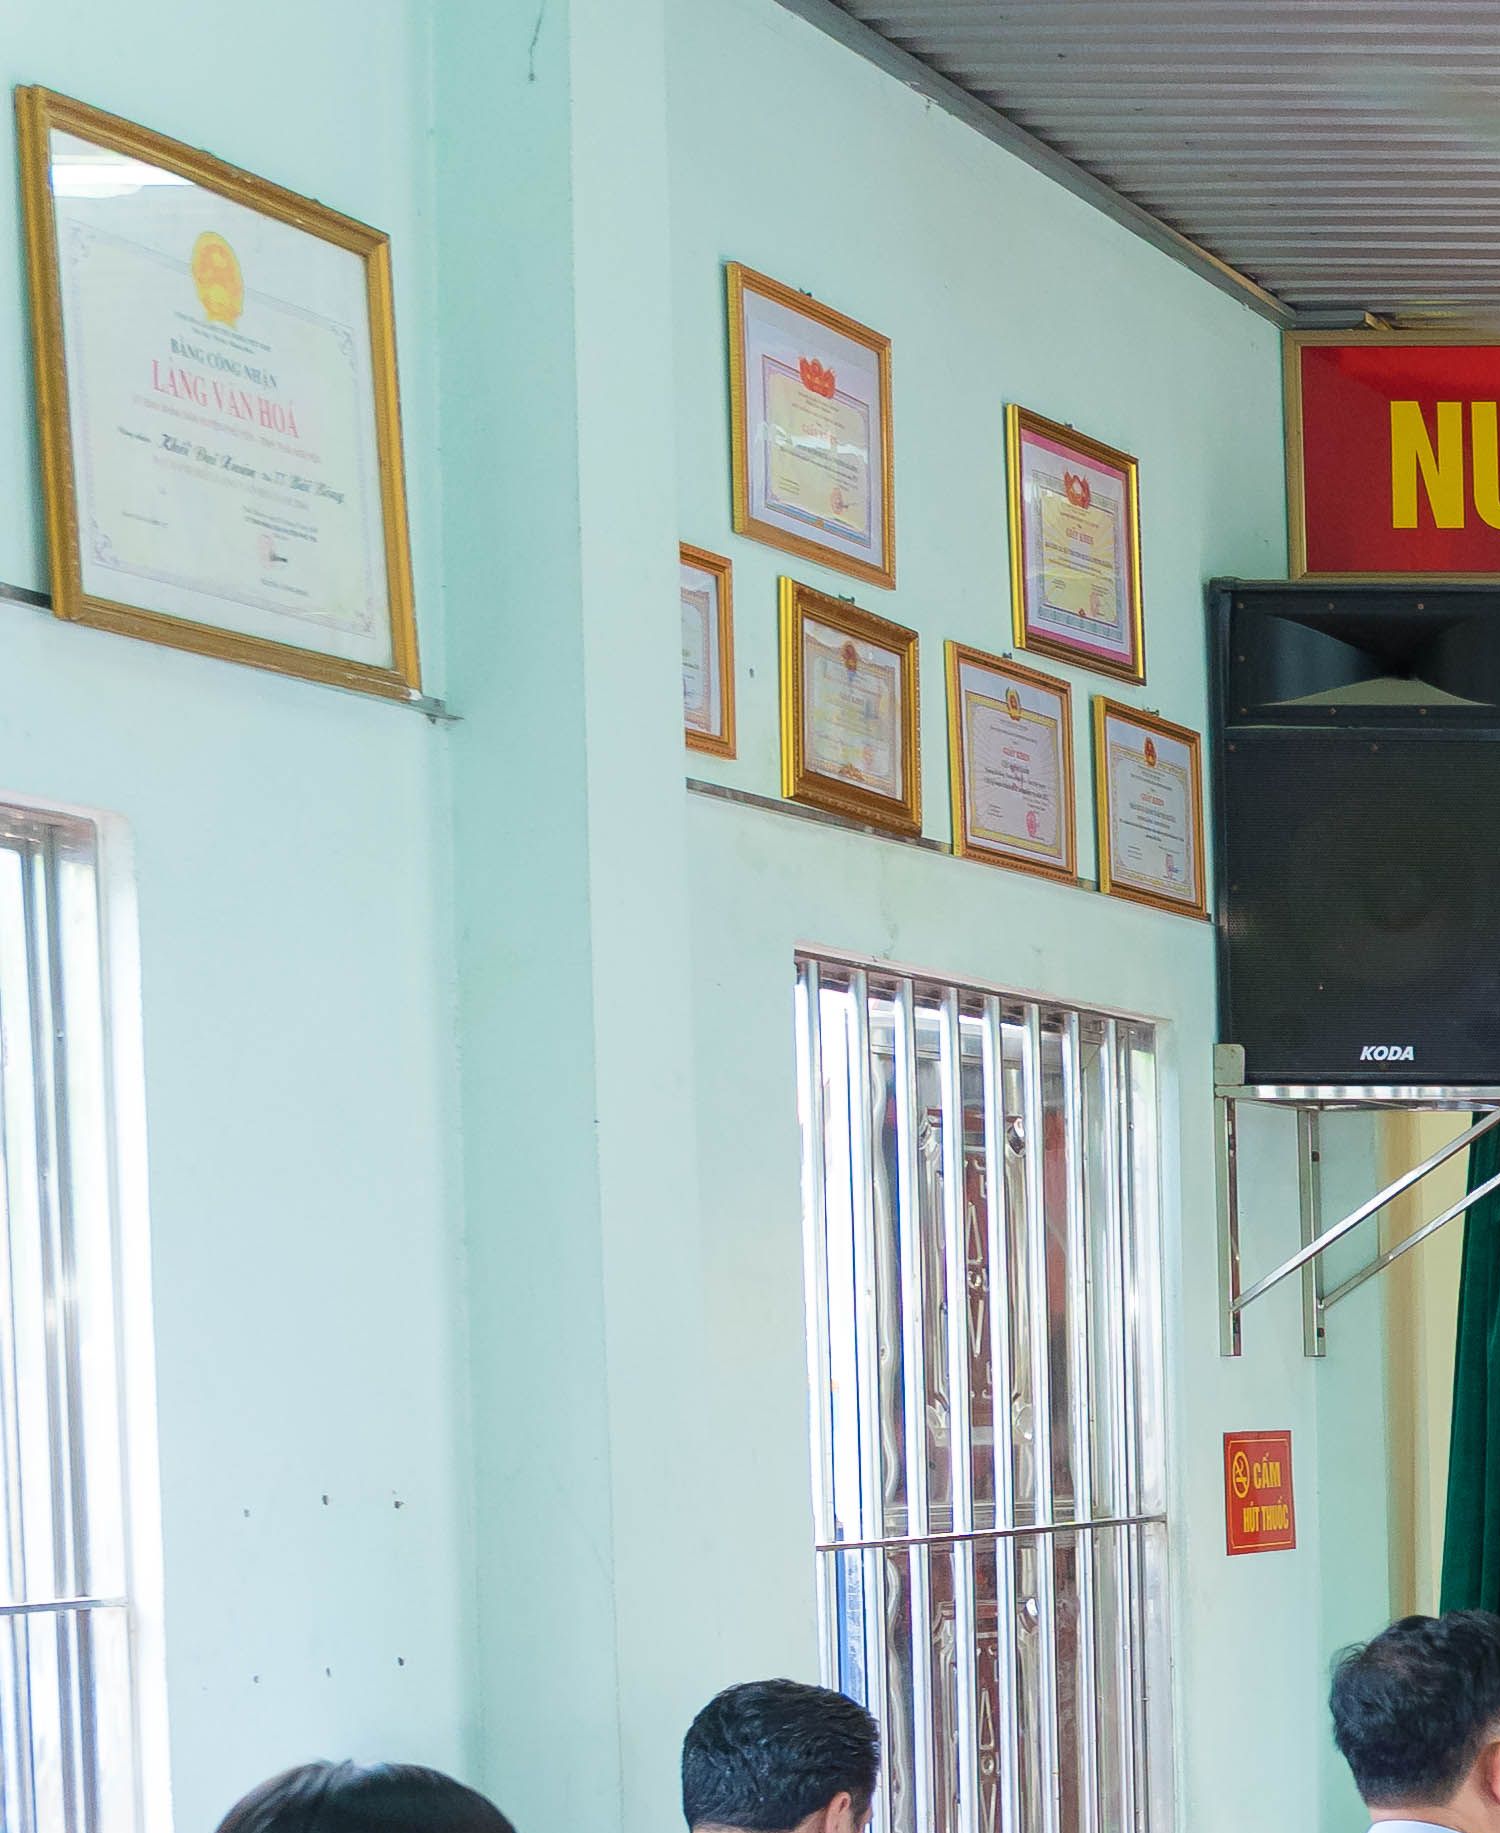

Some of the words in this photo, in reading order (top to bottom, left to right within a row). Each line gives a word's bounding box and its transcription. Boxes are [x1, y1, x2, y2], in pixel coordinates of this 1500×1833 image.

[1360, 1046, 1414, 1060] KODA
[1253, 1452, 1281, 1489] CẤM
[1243, 1501, 1260, 1533] HÚT
[1261, 1496, 1289, 1532] THUỐC
